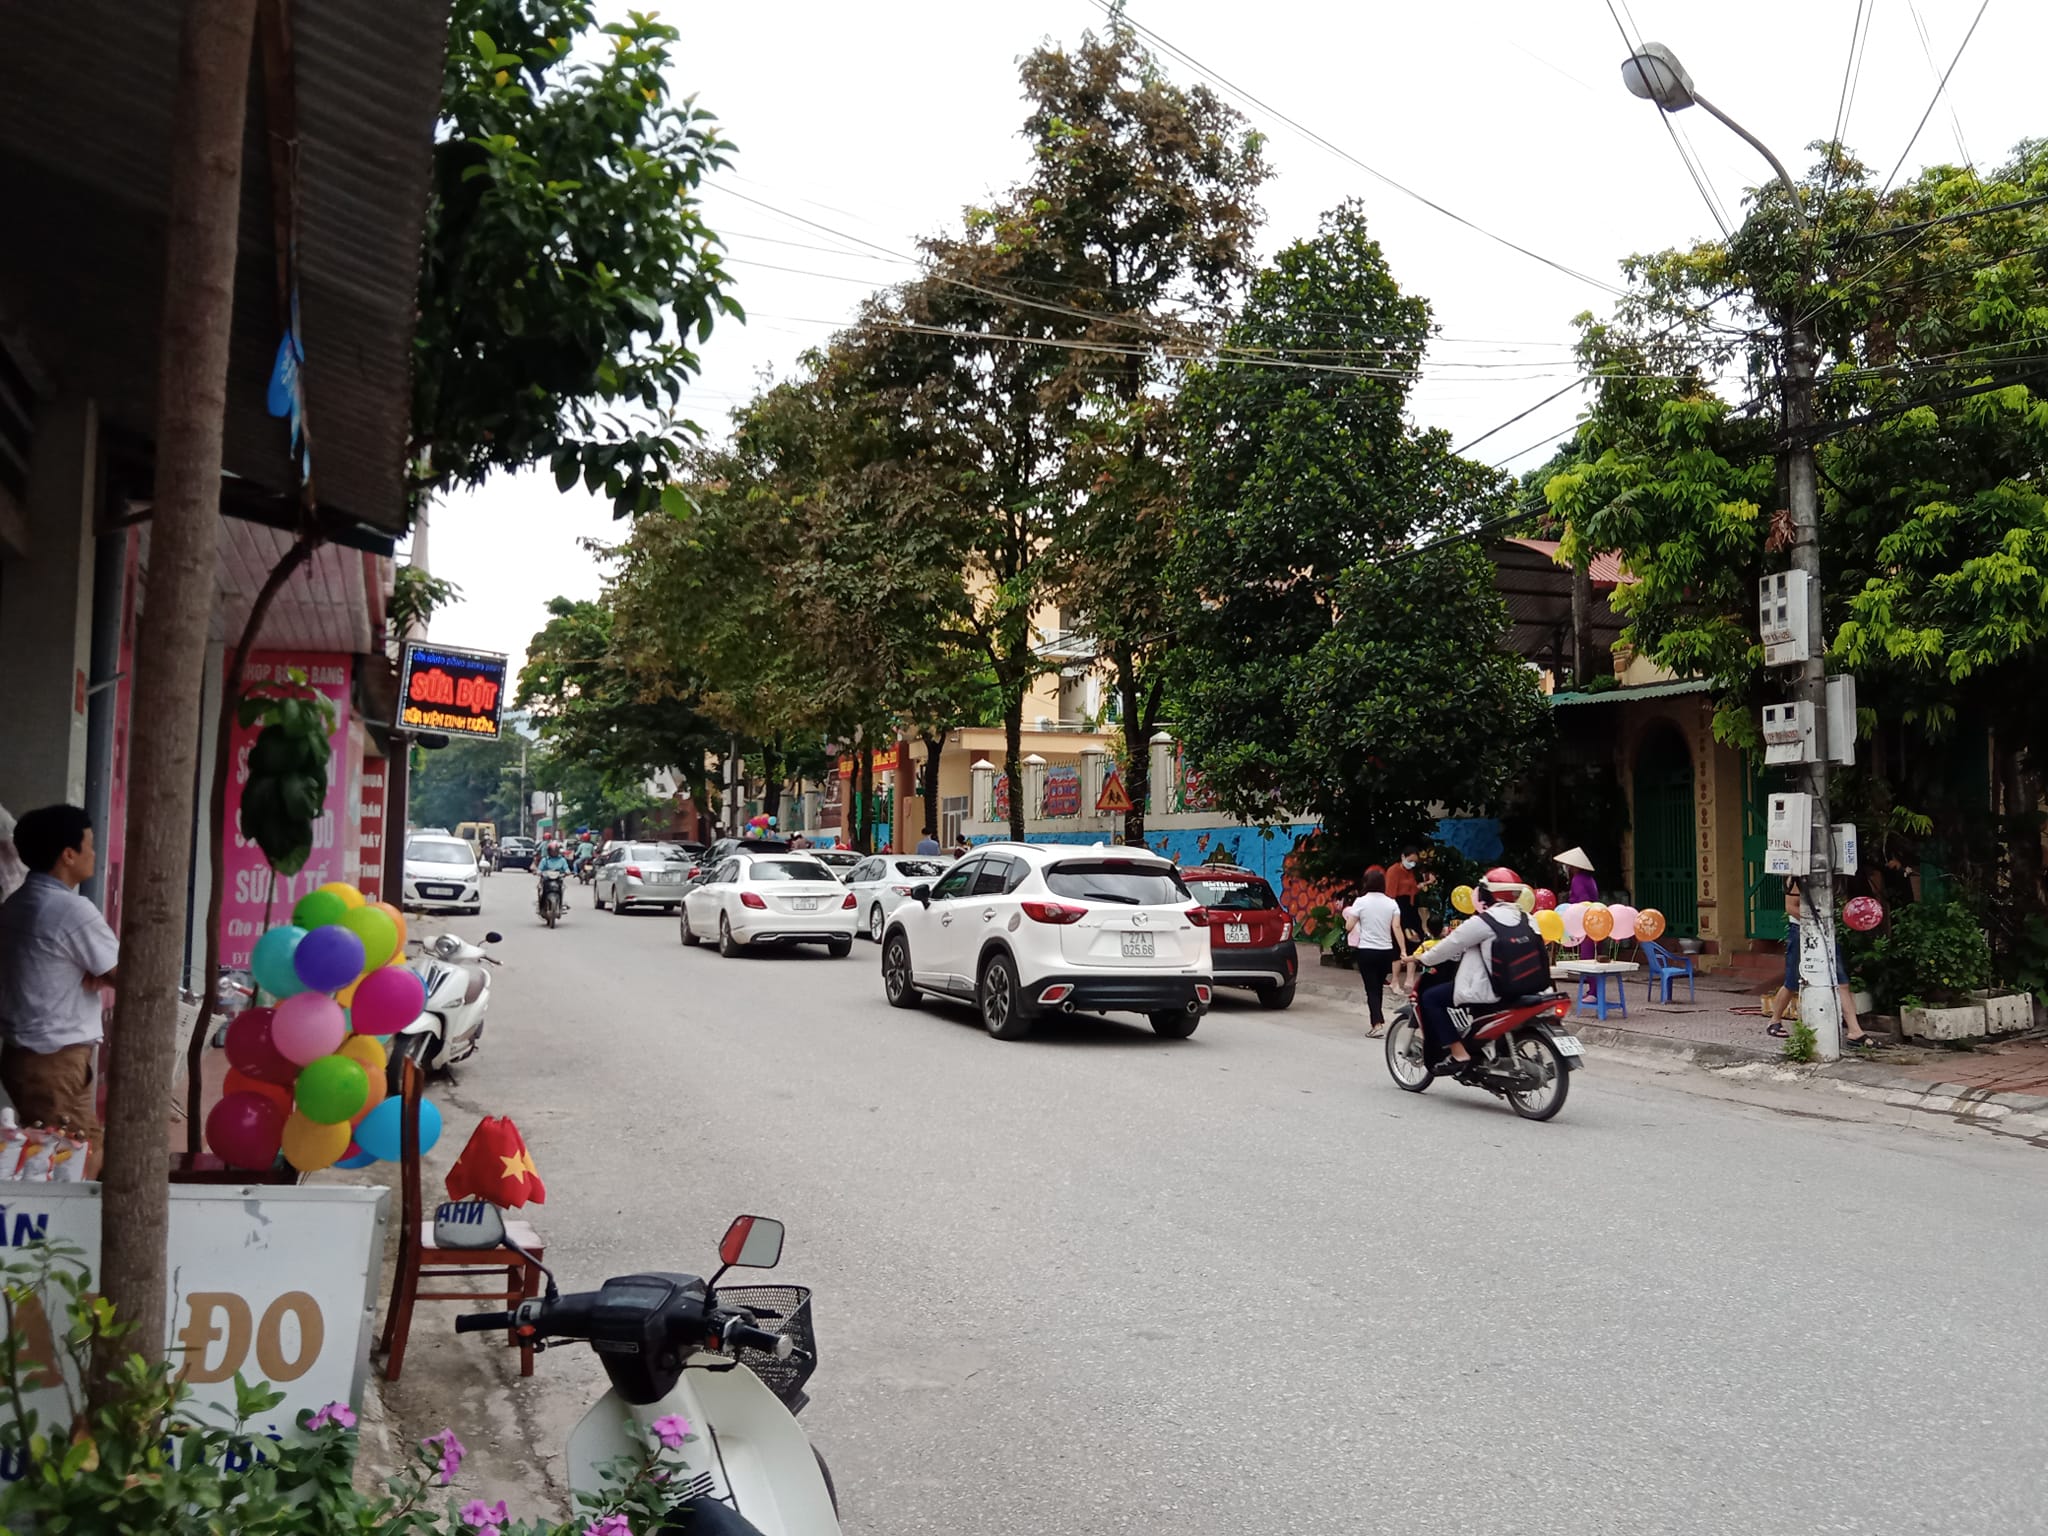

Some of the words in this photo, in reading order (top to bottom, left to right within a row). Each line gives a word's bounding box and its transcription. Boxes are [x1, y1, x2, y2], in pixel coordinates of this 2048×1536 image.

[243, 664, 272, 681] HOP
[410, 667, 454, 705] SỮA
[455, 675, 498, 714] BỘT
[235, 863, 280, 904] SỮA
[228, 918, 252, 937] Cho
[1128, 933, 1147, 944] 27A
[176, 1291, 325, 1384] ĐO
